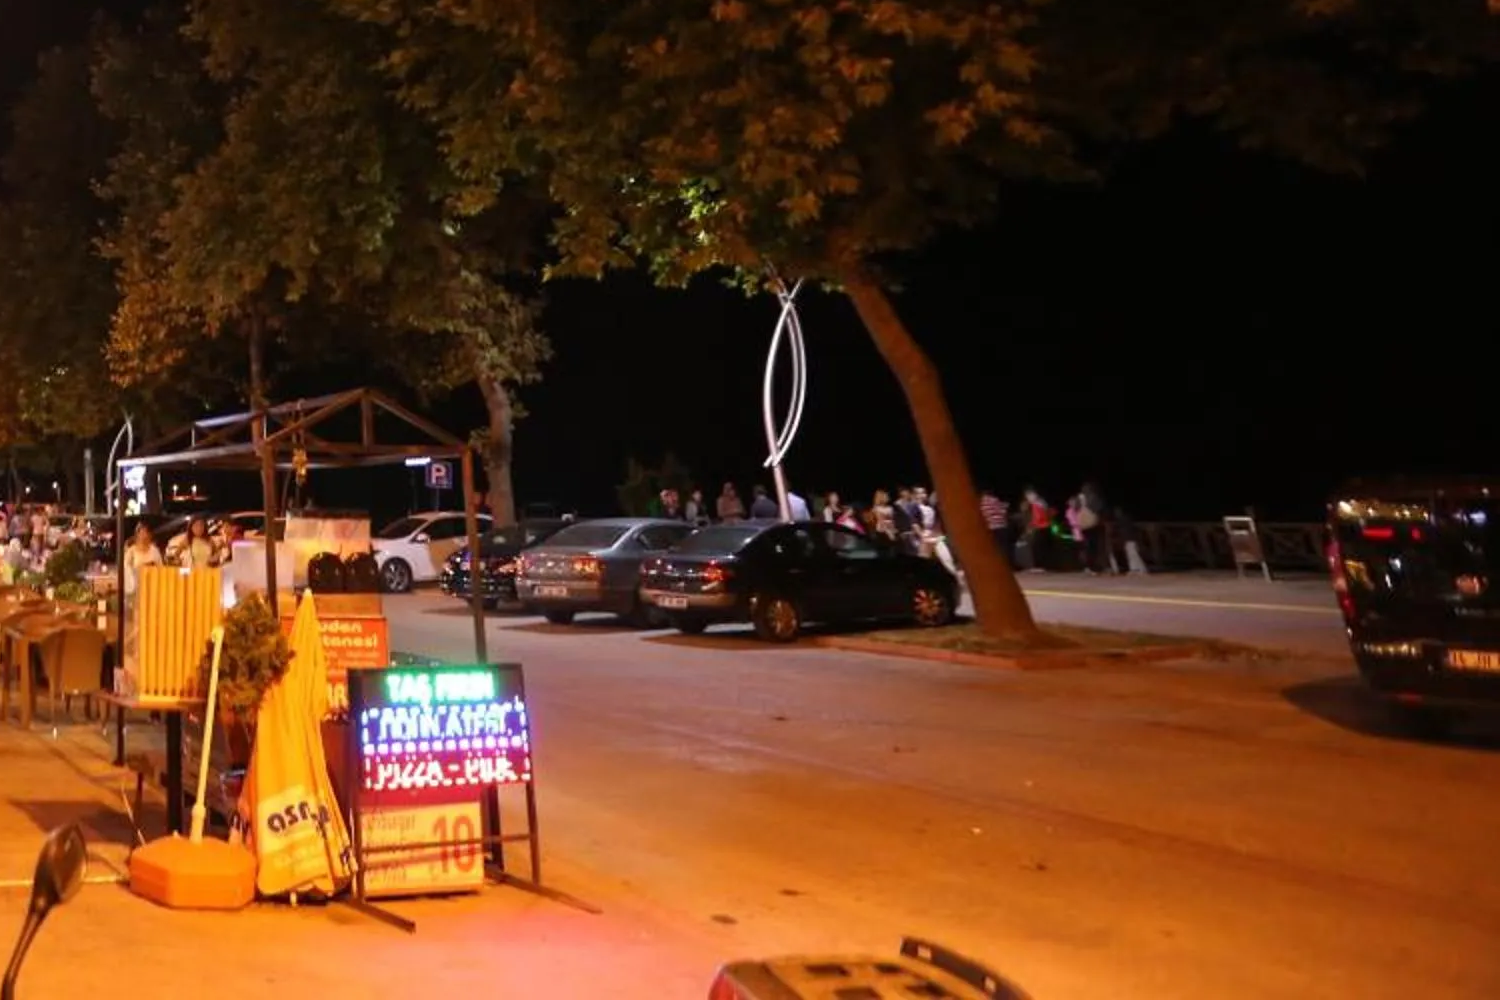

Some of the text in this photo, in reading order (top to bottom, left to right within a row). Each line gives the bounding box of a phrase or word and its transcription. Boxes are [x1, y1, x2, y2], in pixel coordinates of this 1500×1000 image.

[431, 463, 446, 484] P
[319, 620, 362, 633] uden
[432, 814, 475, 873] 10
